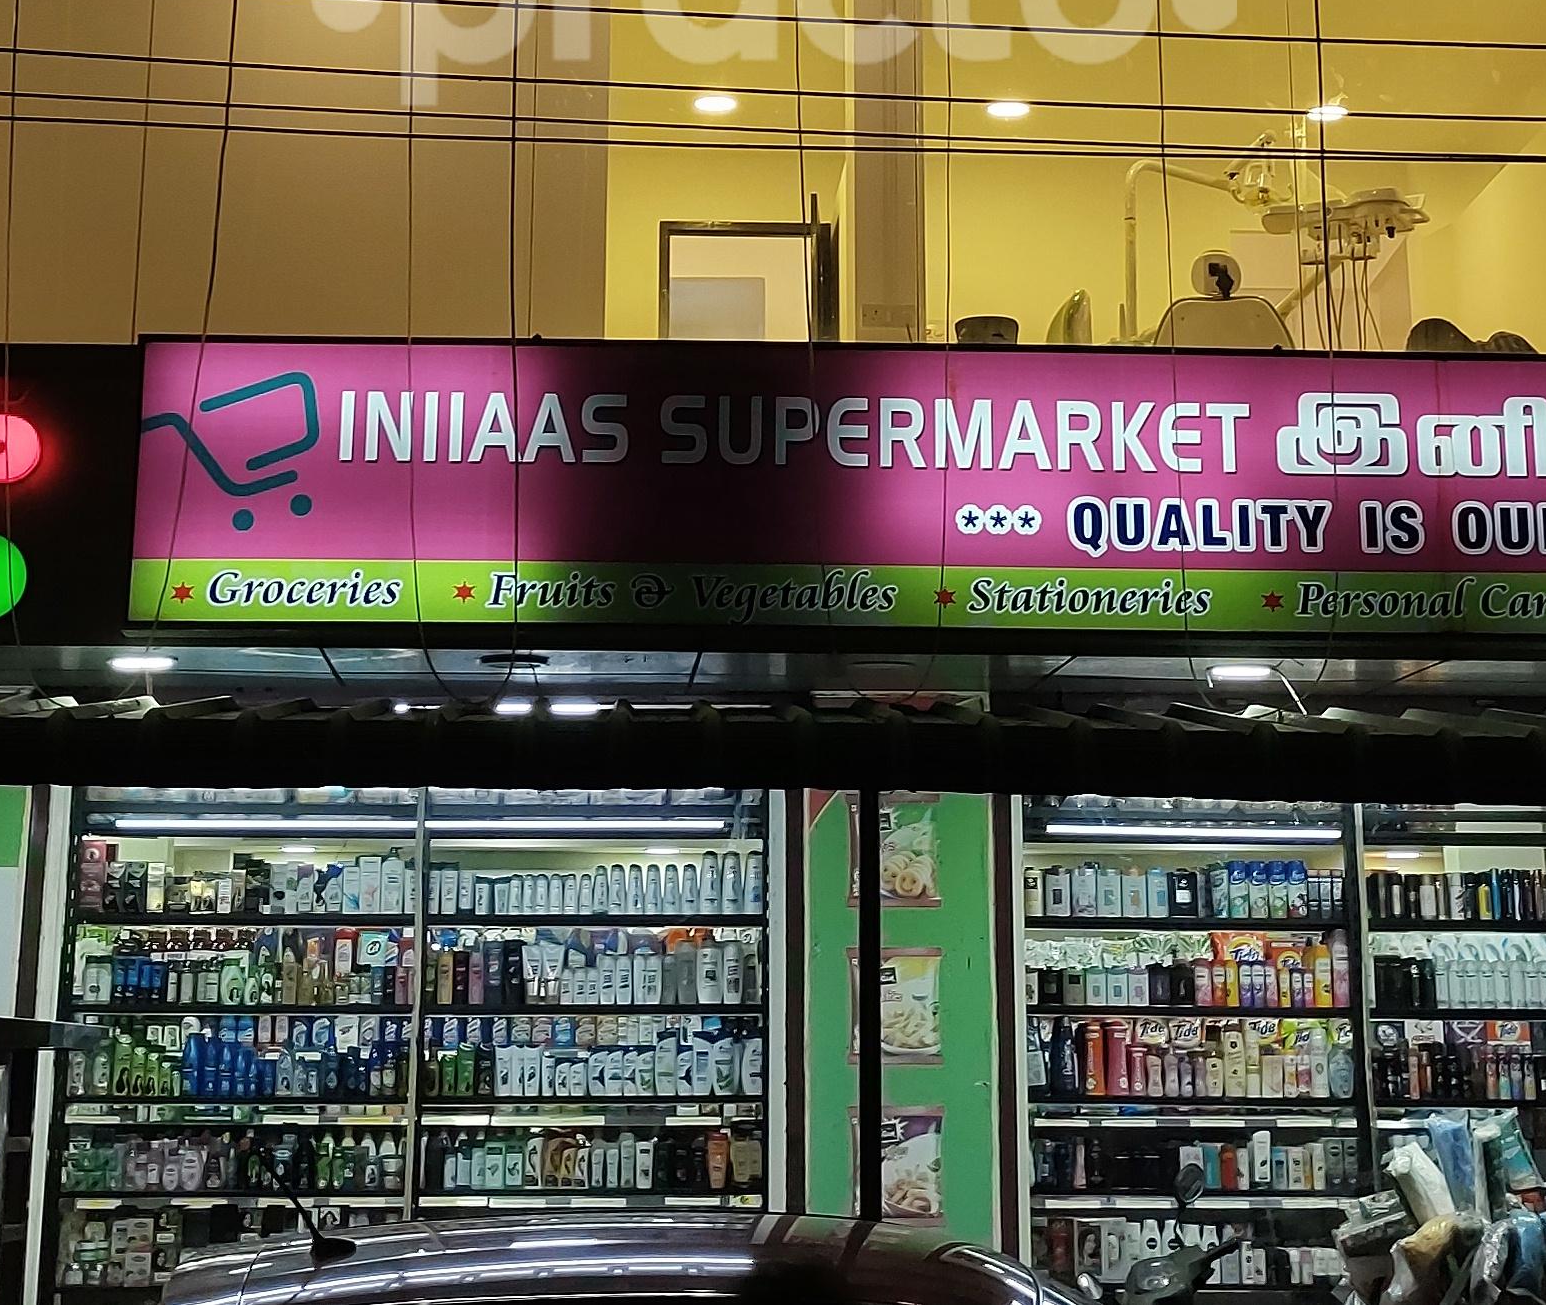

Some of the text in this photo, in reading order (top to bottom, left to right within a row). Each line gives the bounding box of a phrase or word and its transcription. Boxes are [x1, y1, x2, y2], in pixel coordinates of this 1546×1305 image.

[338, 389, 1250, 473] INIIAAS SUPERMARKET
[1067, 498, 1329, 556] QUALITY
[1361, 501, 1424, 555] IS
[206, 570, 402, 609] Groceries
[485, 572, 614, 611] Fruits
[692, 568, 899, 625] Vegetables
[966, 578, 1212, 617] Stationeries
[1294, 579, 1468, 621] Personal
